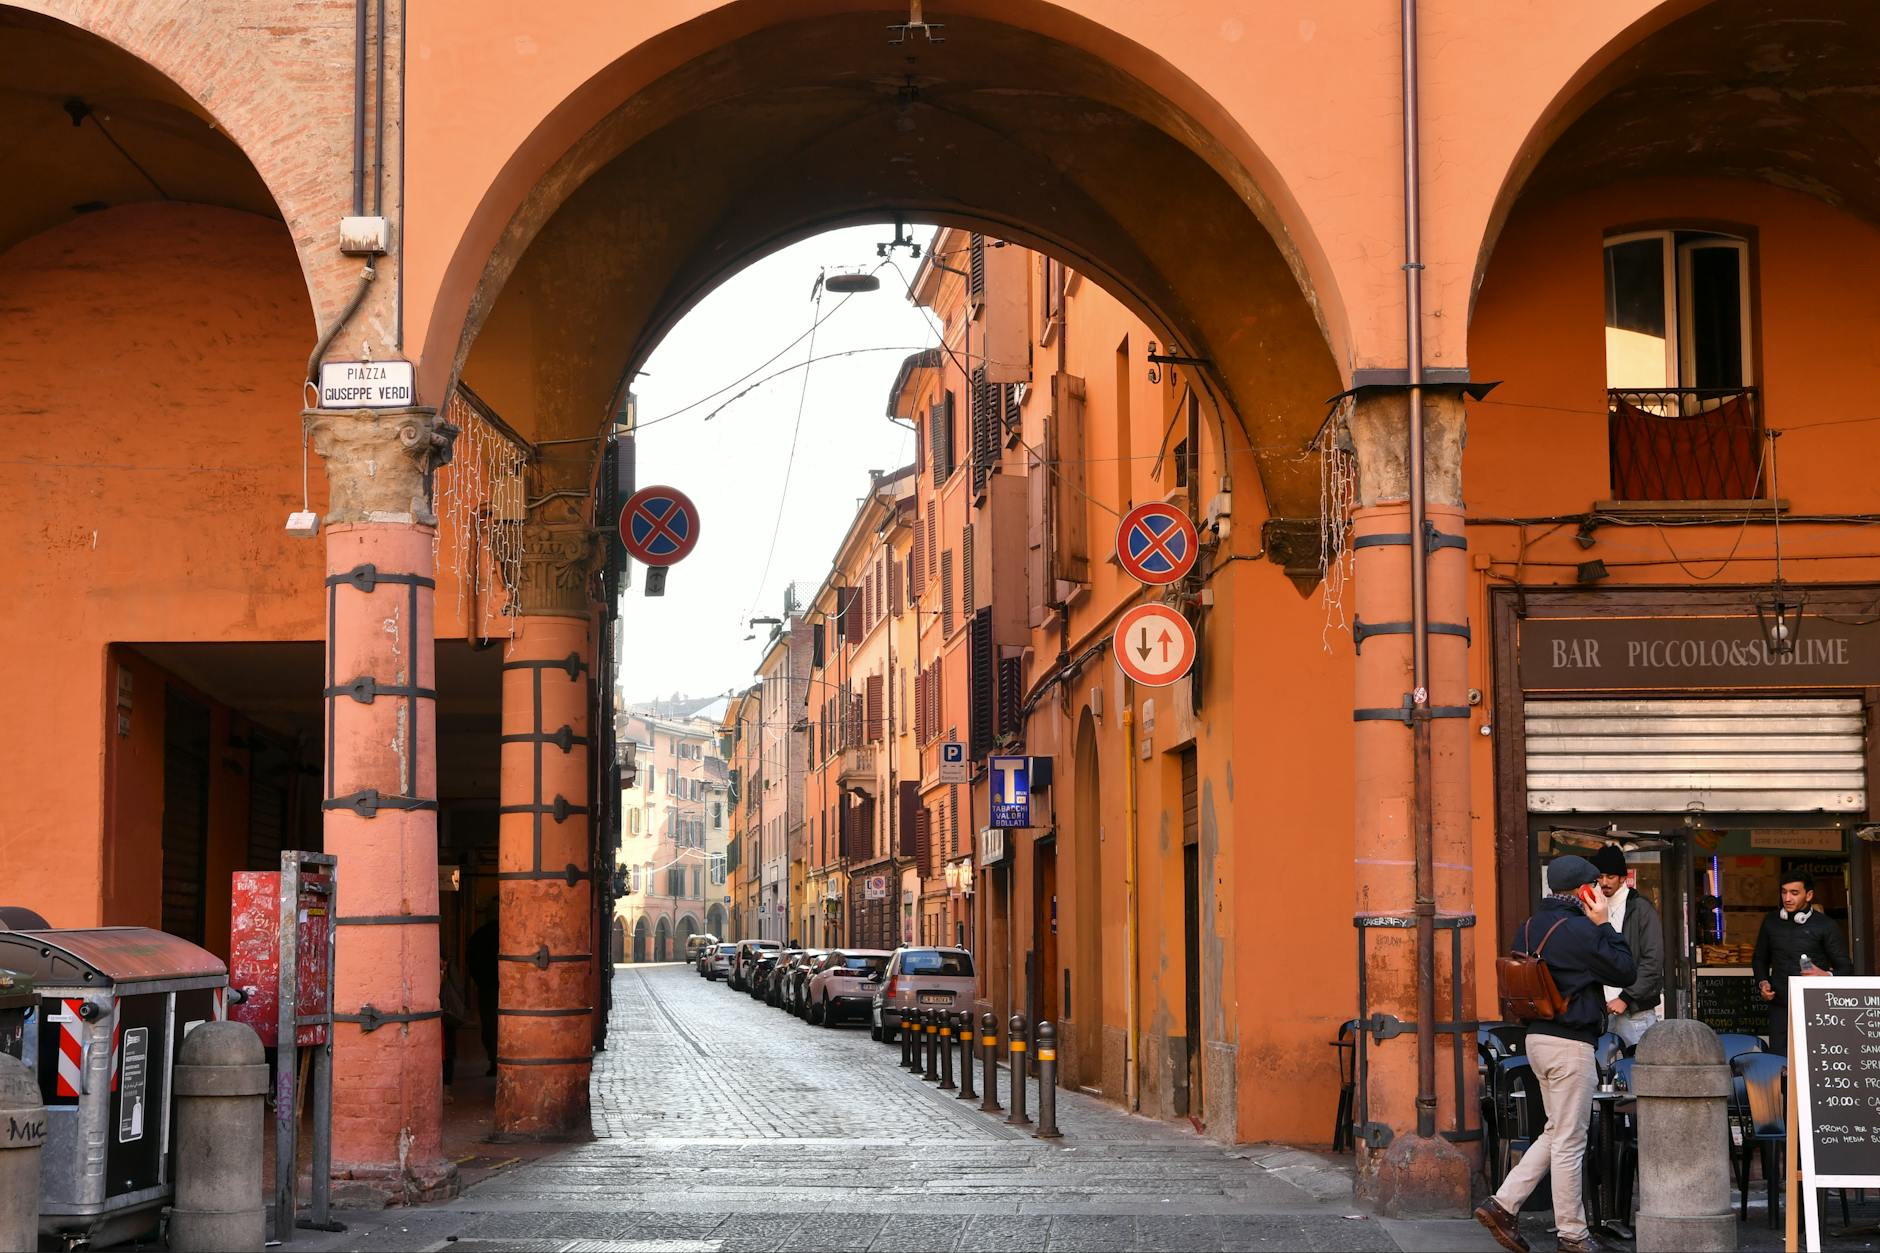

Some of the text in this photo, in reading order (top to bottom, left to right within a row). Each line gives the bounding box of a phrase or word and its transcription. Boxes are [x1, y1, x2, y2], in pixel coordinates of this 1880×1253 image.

[347, 368, 386, 380] PIAZZA
[325, 386, 409, 400] GIUSEPPE VERDI
[1551, 638, 1601, 668] BAR
[947, 746, 959, 760] P
